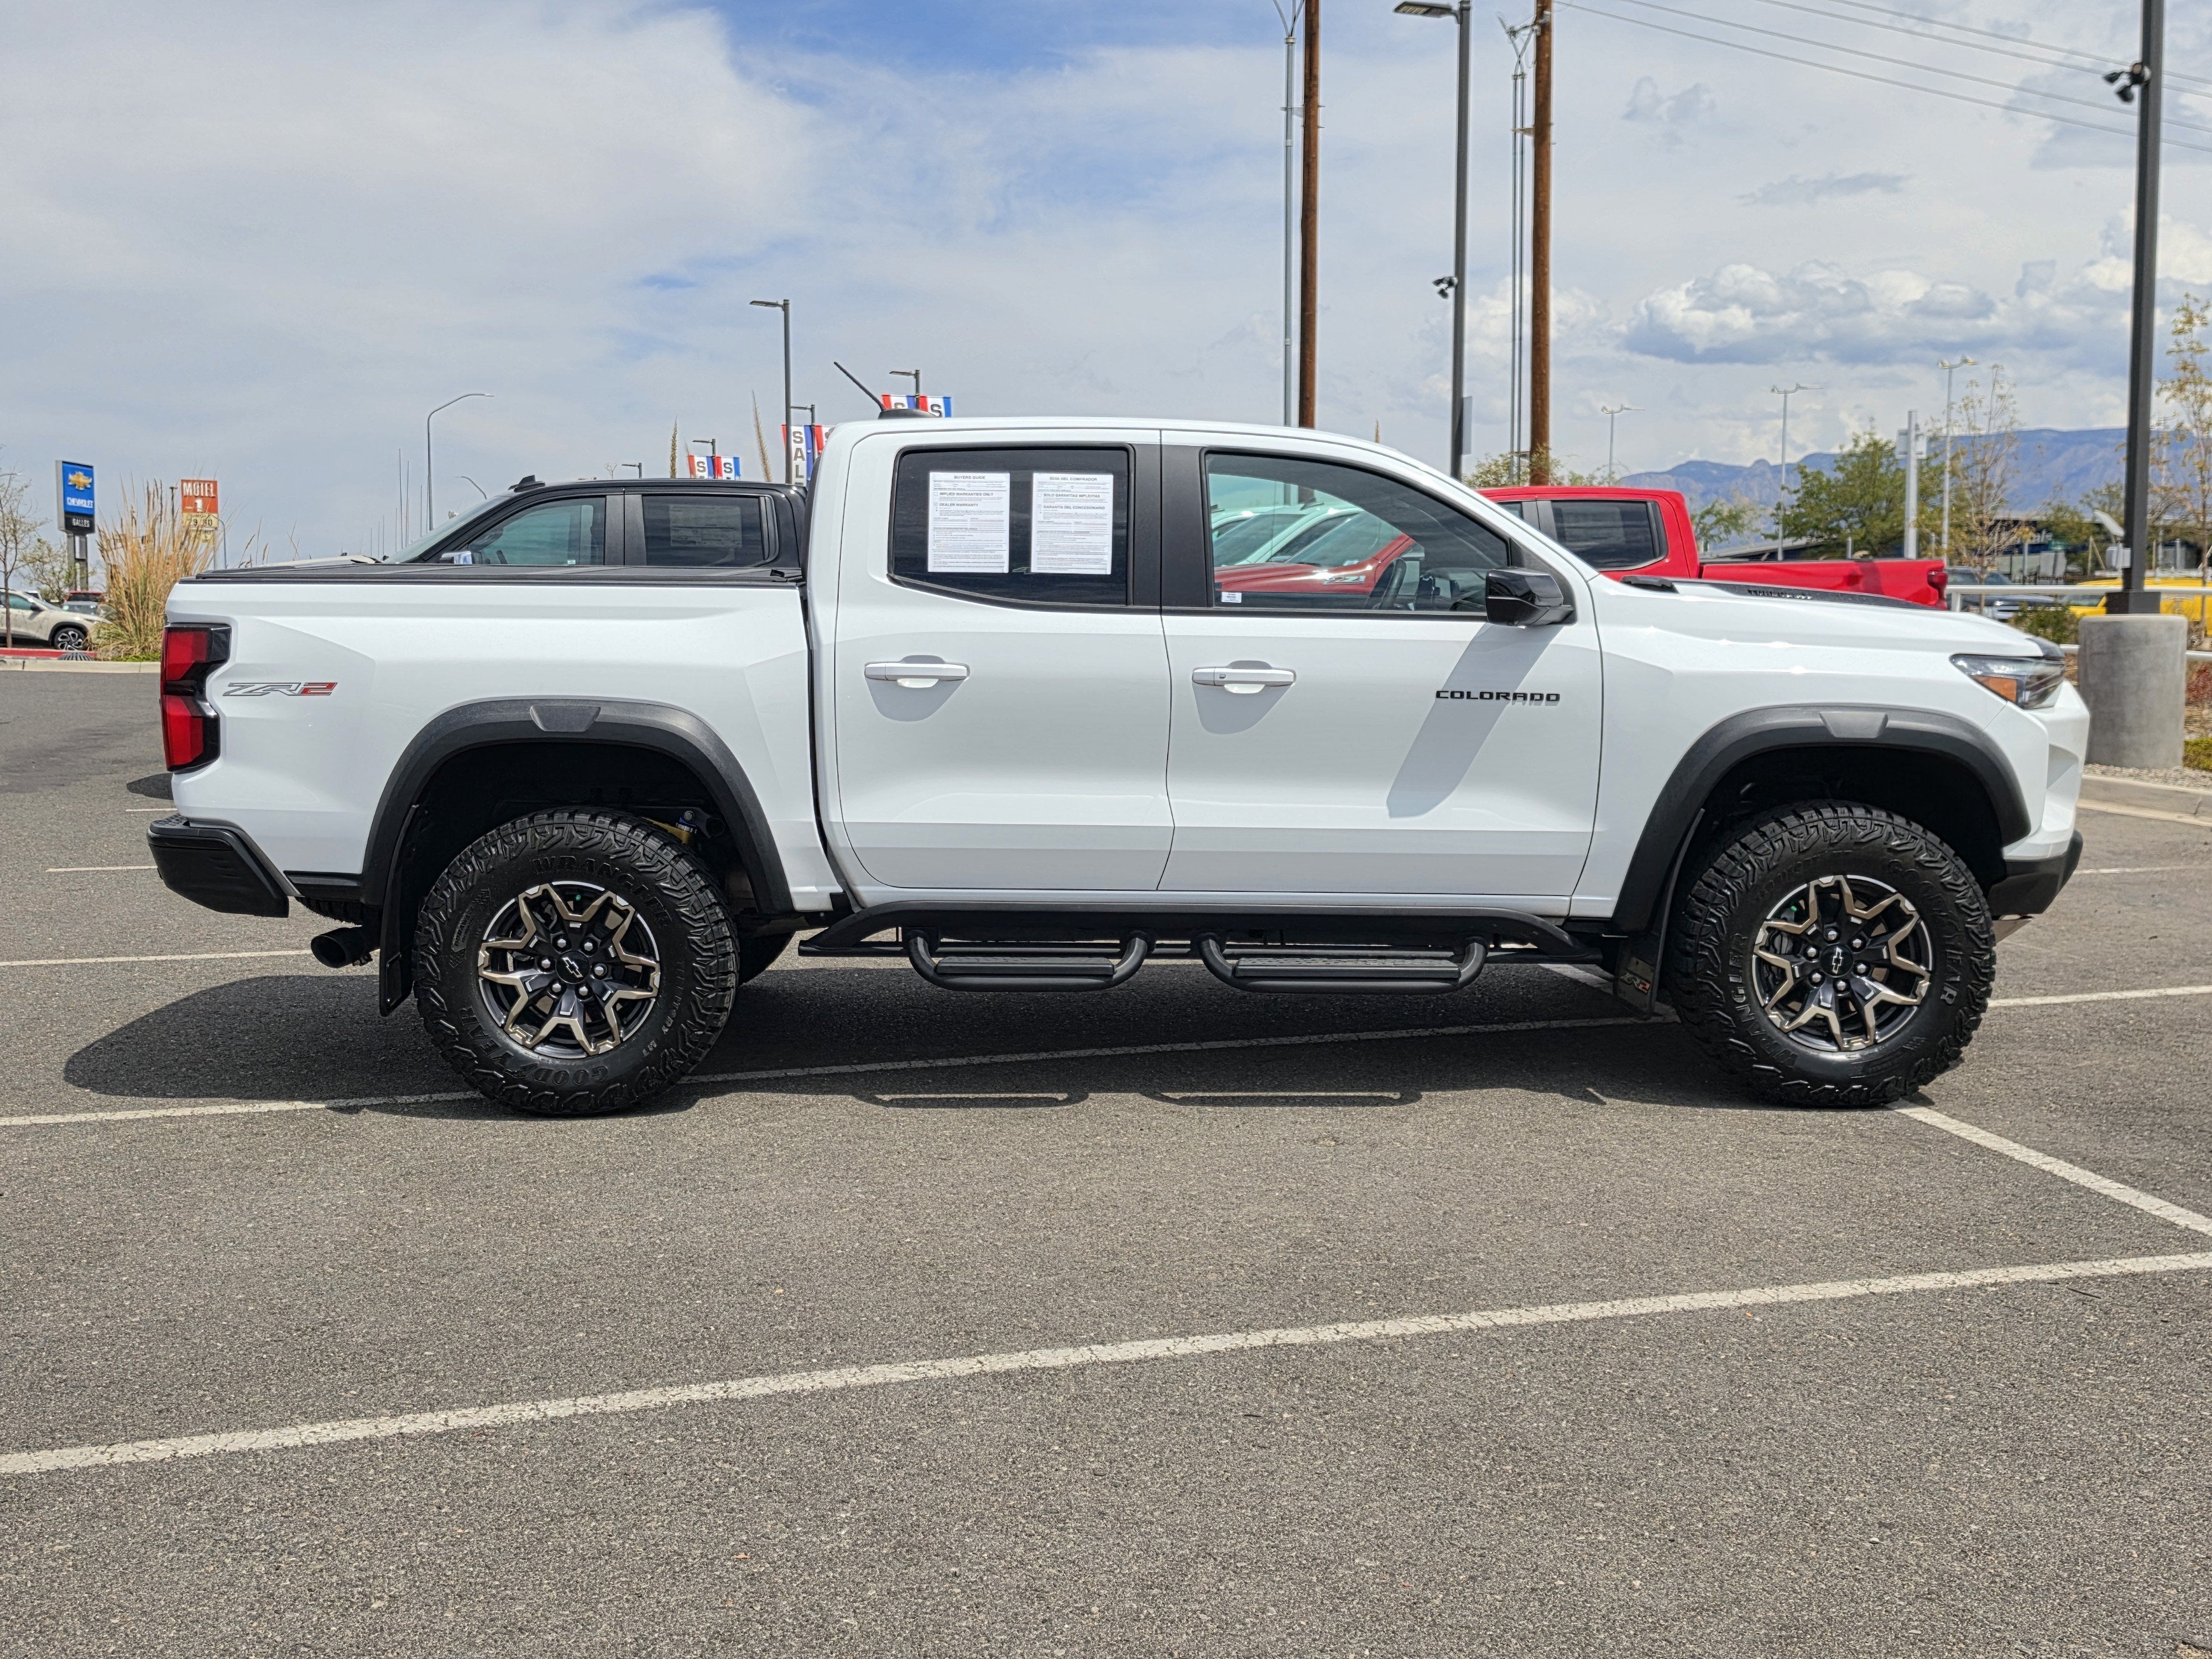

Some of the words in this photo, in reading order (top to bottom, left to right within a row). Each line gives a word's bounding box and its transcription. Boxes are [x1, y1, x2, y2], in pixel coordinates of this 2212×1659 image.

[792, 431, 806, 486] SAL
[222, 682, 338, 696] ZR2
[1436, 690, 1560, 701] COLORADO
[532, 855, 673, 927] WRANGLER
[1620, 971, 1650, 993] ZR2
